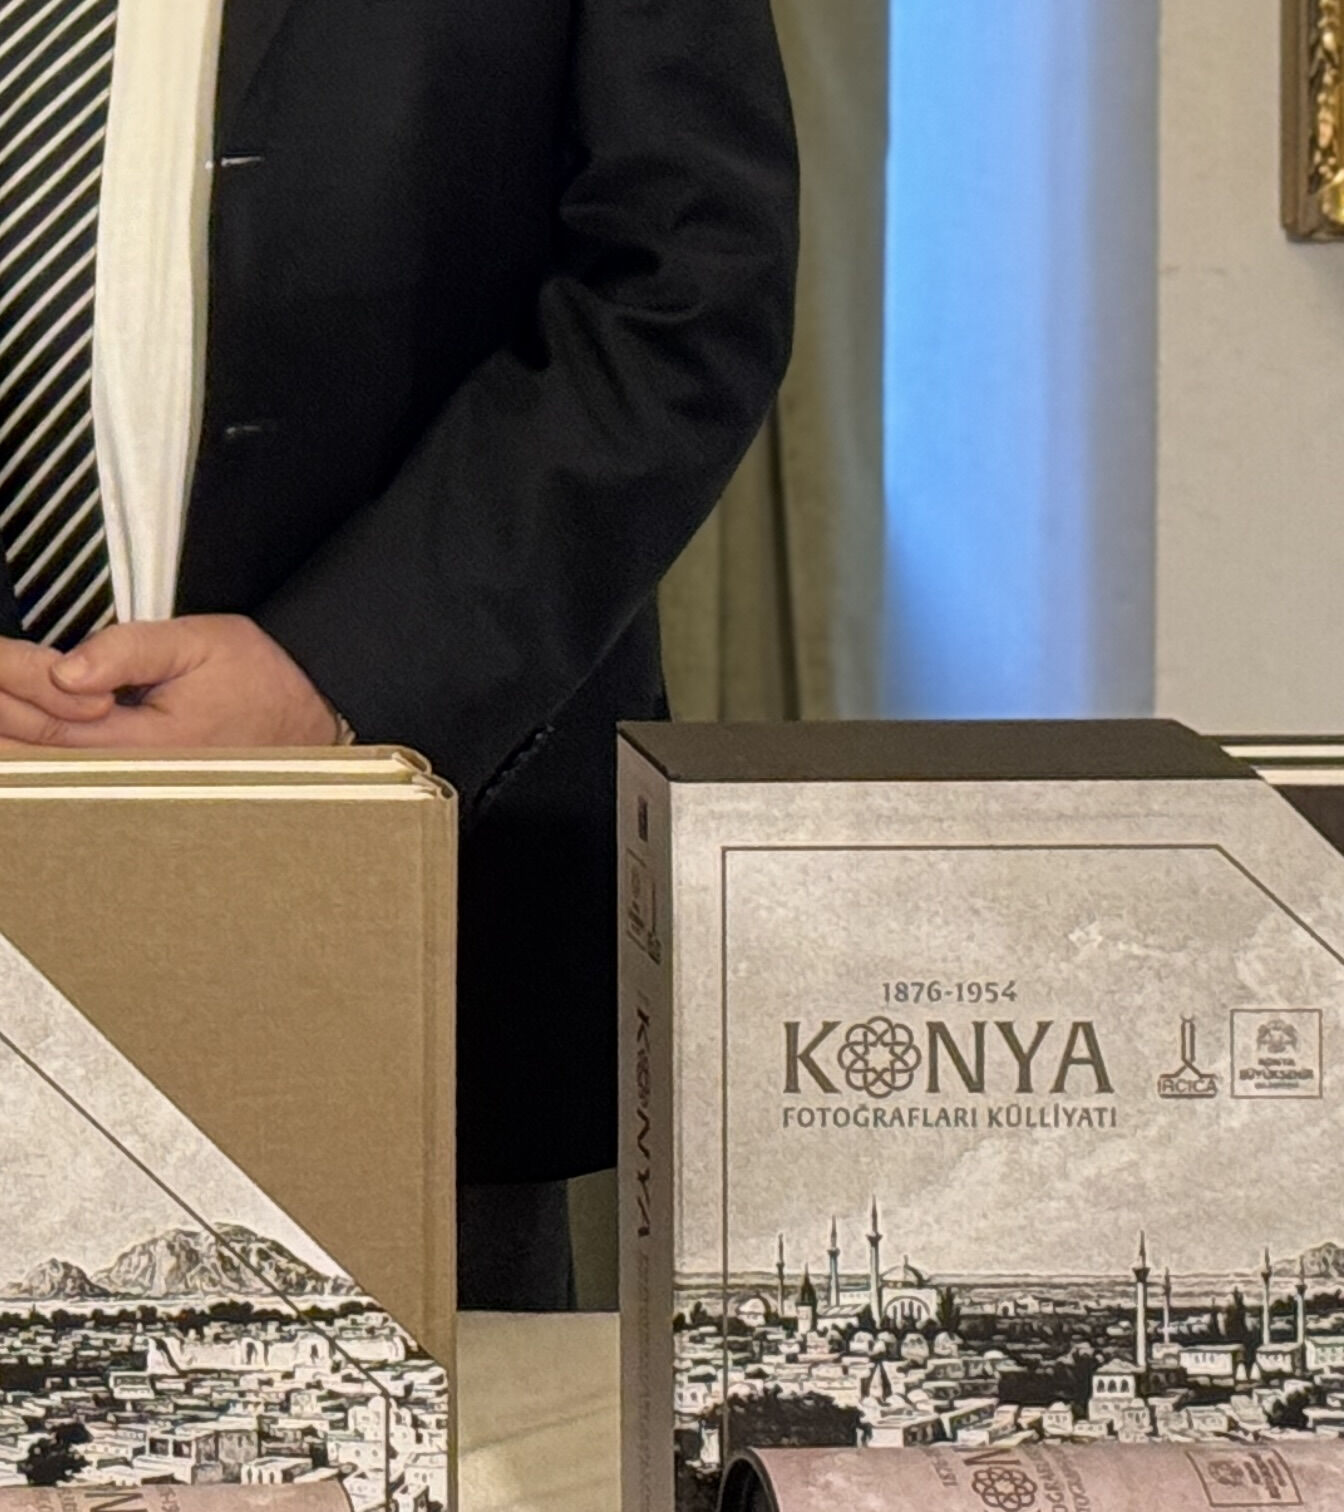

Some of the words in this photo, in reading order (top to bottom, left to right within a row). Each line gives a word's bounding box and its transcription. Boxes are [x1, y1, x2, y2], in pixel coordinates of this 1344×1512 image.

[882, 979, 1018, 1005] 1876-1954
[783, 1015, 1115, 1100] KONYA
[782, 1102, 979, 1130] FOTOĞRAFLARI
[986, 1101, 1118, 1130] KÜLLİYATI
